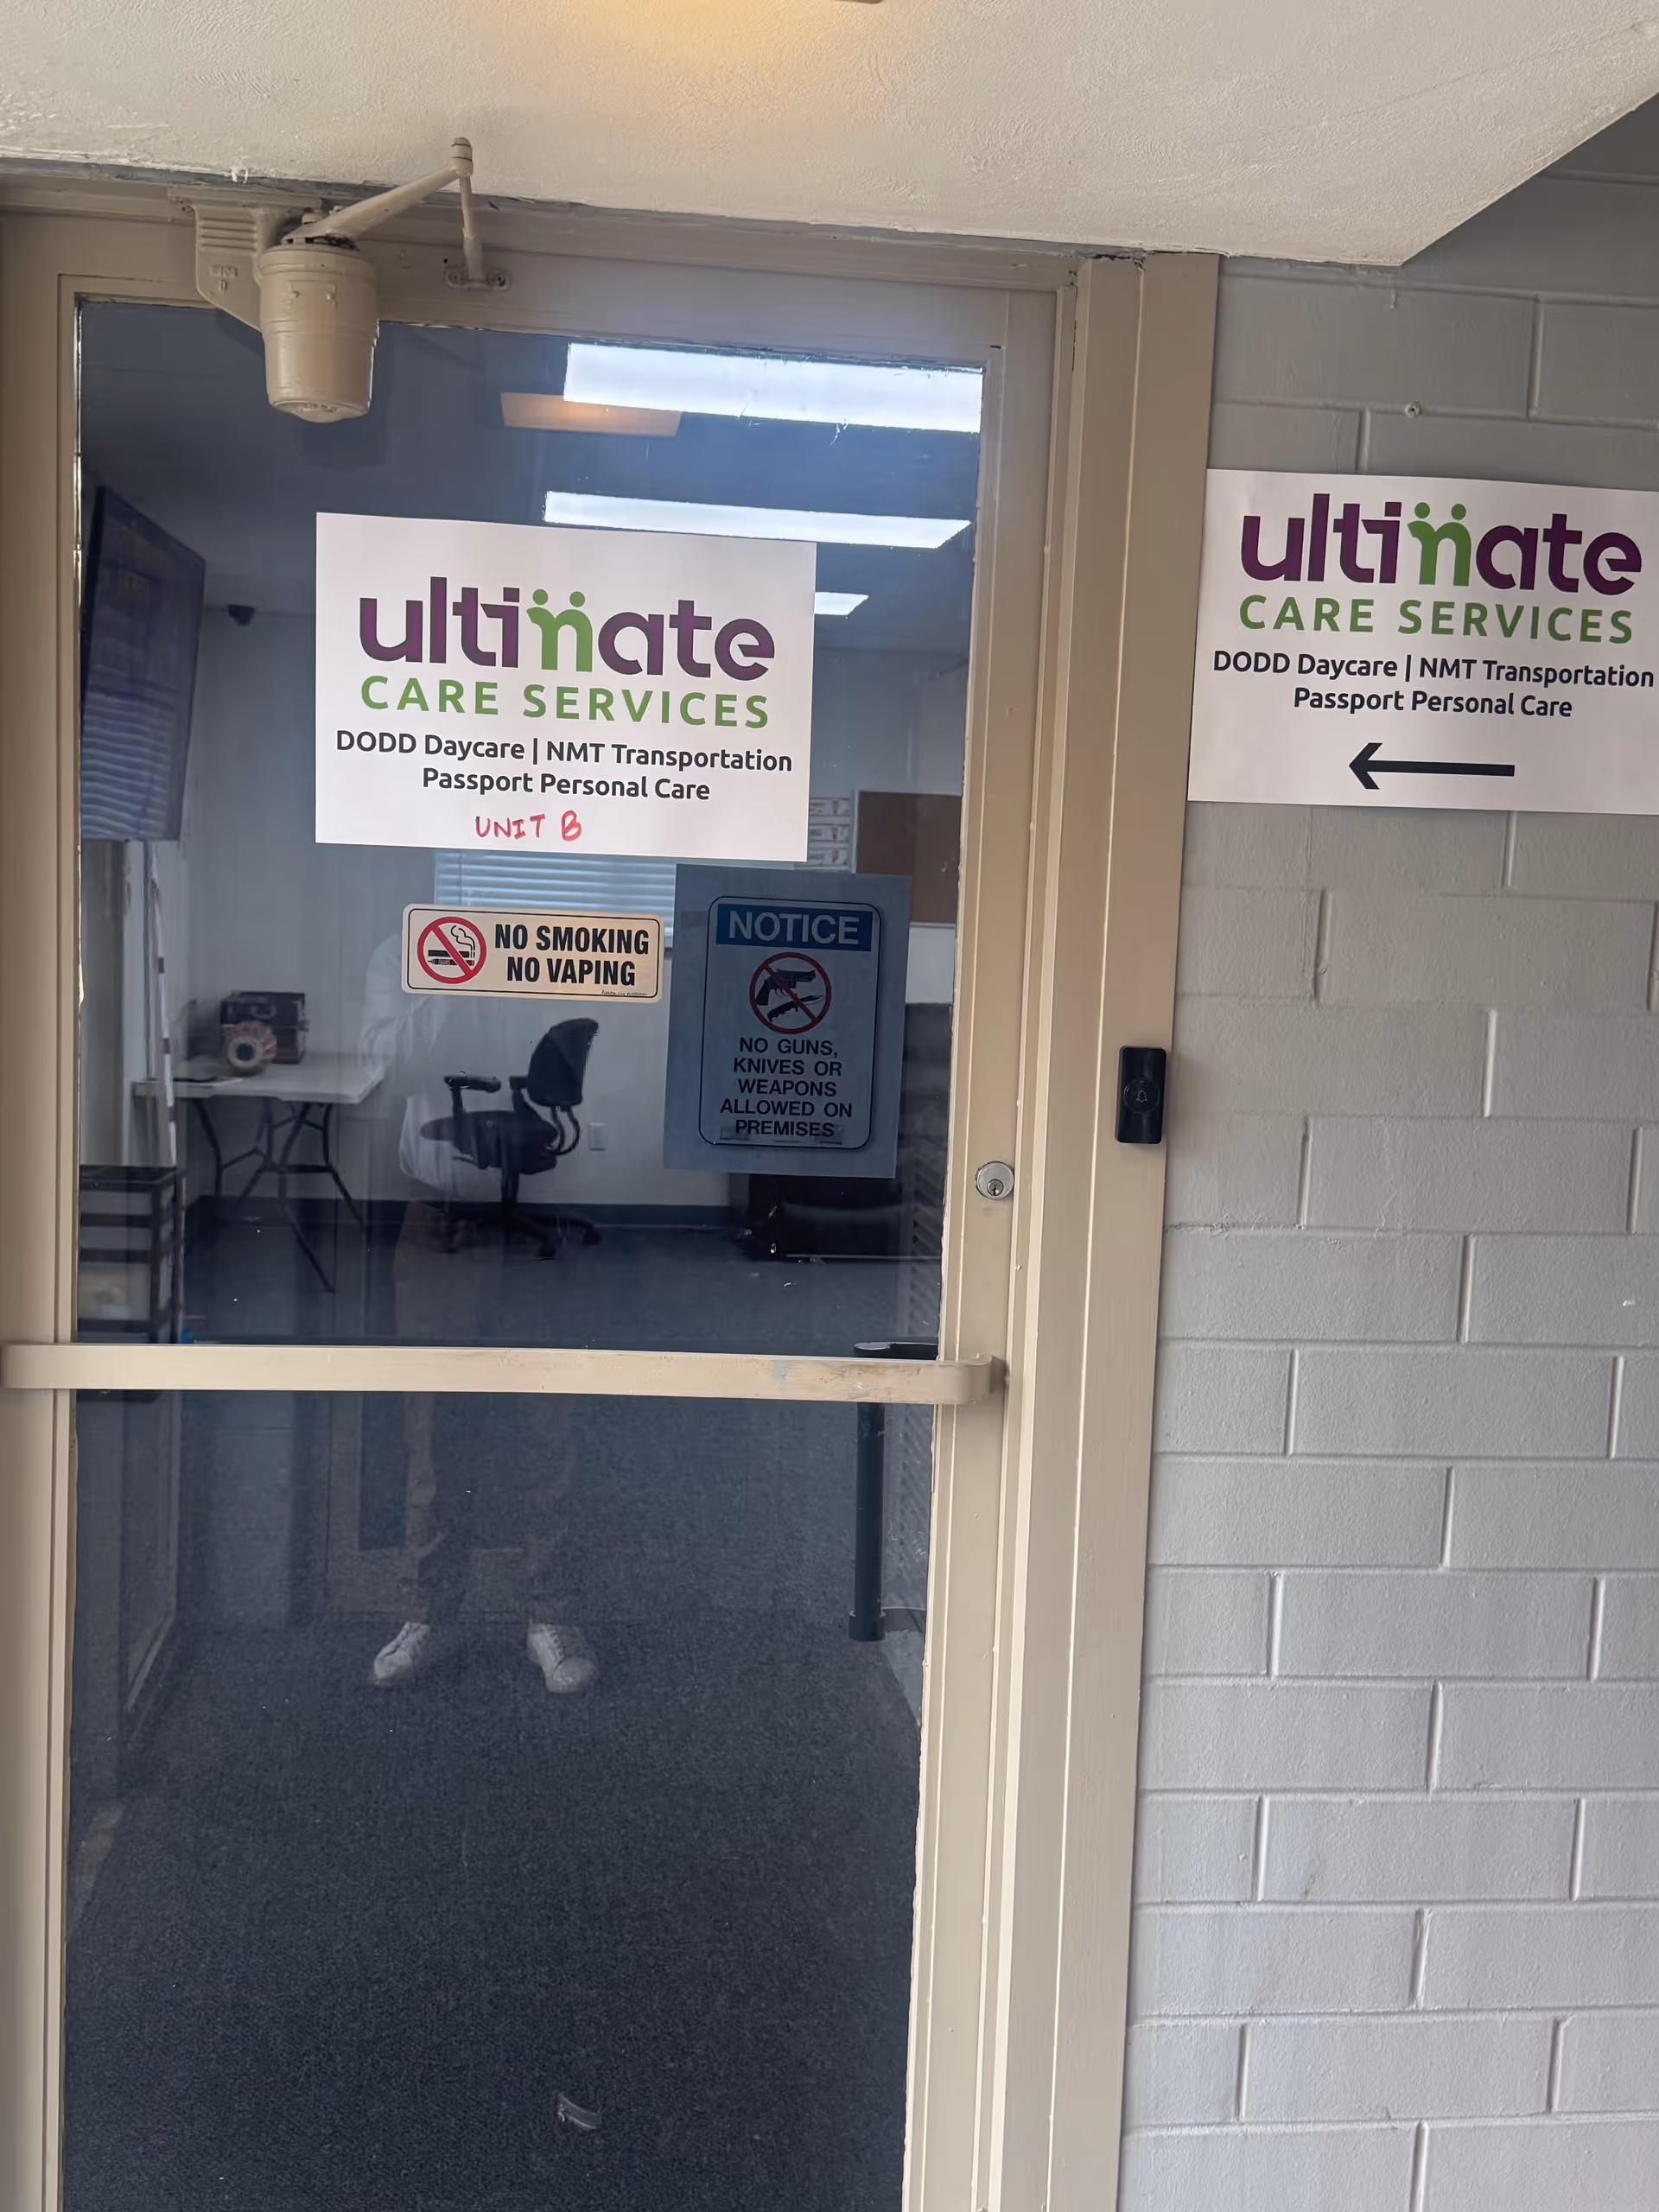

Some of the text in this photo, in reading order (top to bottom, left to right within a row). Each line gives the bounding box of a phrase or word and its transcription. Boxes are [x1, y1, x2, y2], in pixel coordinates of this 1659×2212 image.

[1239, 594, 1632, 644] CARE SERVICES
[1213, 651, 1290, 674] DODD
[1297, 654, 1397, 680] Daycare
[1419, 658, 1477, 680] NMT
[1484, 660, 1655, 688] Transportation
[361, 676, 769, 729] CARE SERVICES
[1294, 688, 1573, 717] Passport Personal Care
[336, 730, 416, 753] DODD
[424, 735, 525, 763] Daycare
[547, 741, 605, 763] NMT
[611, 744, 792, 772] Transportation
[423, 767, 710, 800] Passport Personal Care
[475, 810, 582, 842] UNIT B
[495, 924, 649, 954] NO SMOKING
[728, 911, 860, 944] NOTICE
[507, 957, 635, 986] NO VAPING
[740, 1037, 838, 1058] NO GUNS,
[734, 1058, 842, 1077] KNIVES OR
[738, 1079, 836, 1096] WEAPONS
[720, 1098, 852, 1117] ALLOWED ON
[735, 1120, 835, 1137] PREMISES
